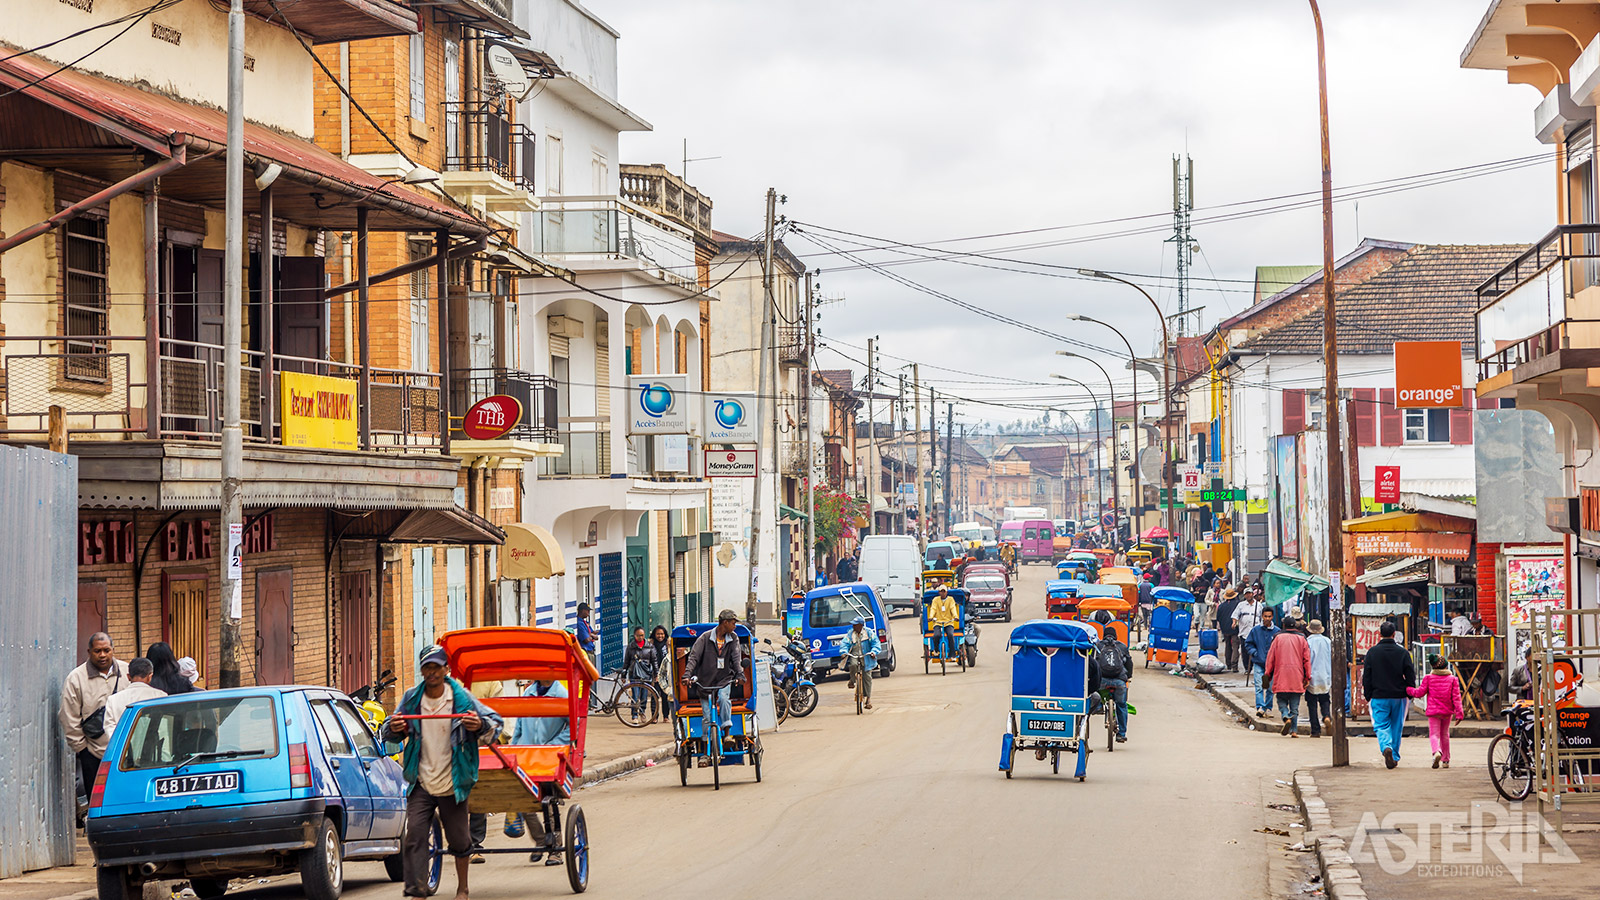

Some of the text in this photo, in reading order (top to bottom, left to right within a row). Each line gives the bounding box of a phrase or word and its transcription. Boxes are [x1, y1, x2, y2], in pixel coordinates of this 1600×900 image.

[1399, 389, 1454, 404] orange
[476, 410, 505, 426] THB
[634, 419, 684, 429] AccèsBanque
[709, 431, 753, 439] AccèsBanque
[708, 462, 754, 470] MoneyGram
[1203, 491, 1232, 500] 08:24
[82, 521, 135, 565] ESTO
[167, 520, 212, 561] BAR
[232, 557, 239, 567] 2
[1031, 700, 1064, 710] TELL
[1560, 712, 1590, 721] Orange
[1560, 720, 1588, 729] Money
[160, 778, 198, 793] 4817
